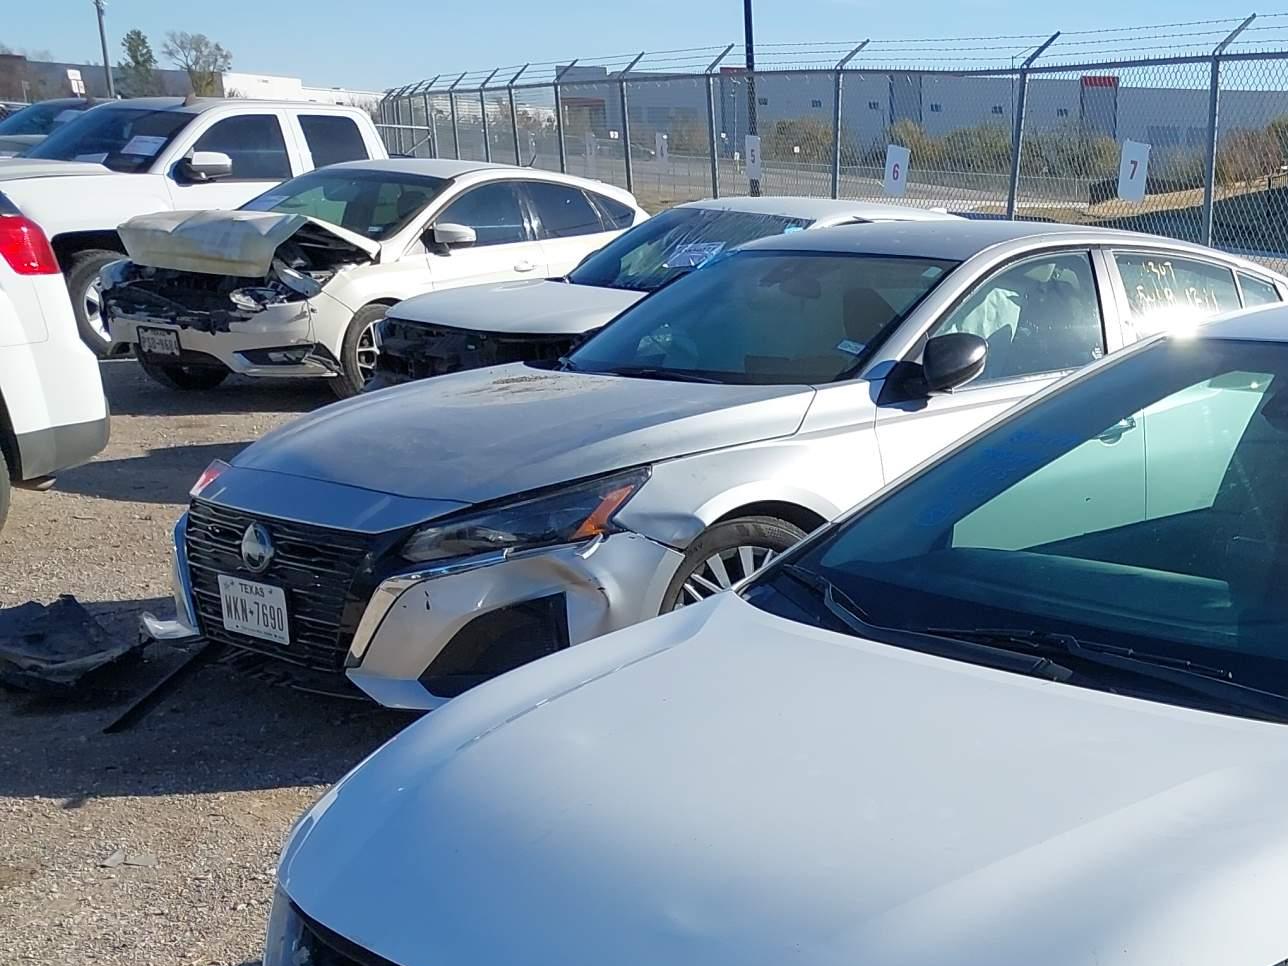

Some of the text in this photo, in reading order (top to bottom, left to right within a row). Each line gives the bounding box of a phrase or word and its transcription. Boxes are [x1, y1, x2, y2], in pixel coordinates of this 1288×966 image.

[892, 163, 900, 181] 6
[1130, 160, 1138, 180] 7
[239, 582, 265, 597] TEXAS
